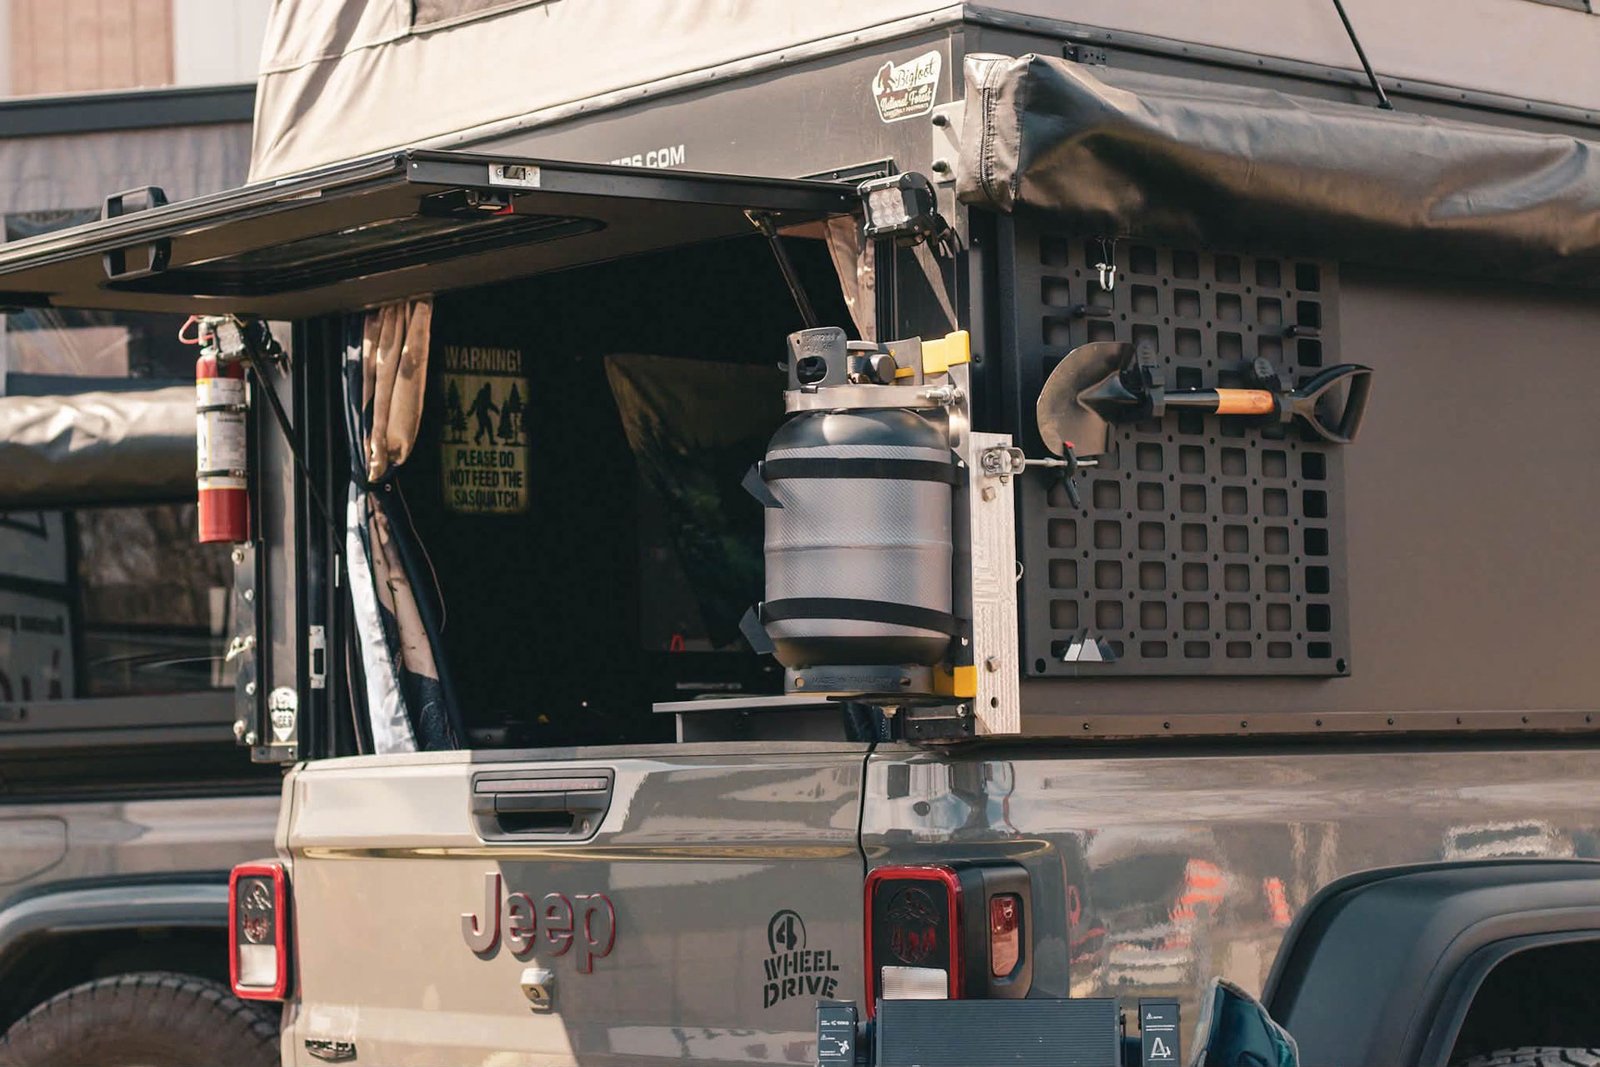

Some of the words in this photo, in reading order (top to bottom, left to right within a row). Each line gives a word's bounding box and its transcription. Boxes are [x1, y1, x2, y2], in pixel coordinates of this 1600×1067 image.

[894, 57, 934, 90] Bigfoot
[445, 346, 522, 372] WARNING!
[457, 450, 497, 467] PLEASE
[500, 451, 515, 468] DO
[450, 469, 470, 487] NOT
[472, 470, 499, 487] FEED
[503, 471, 523, 488] THE
[454, 490, 519, 507] SASQUATCH
[461, 872, 616, 974] Jeep
[776, 915, 798, 950] 4
[763, 950, 839, 981] WHEEL
[763, 975, 838, 1008] DRIVE
